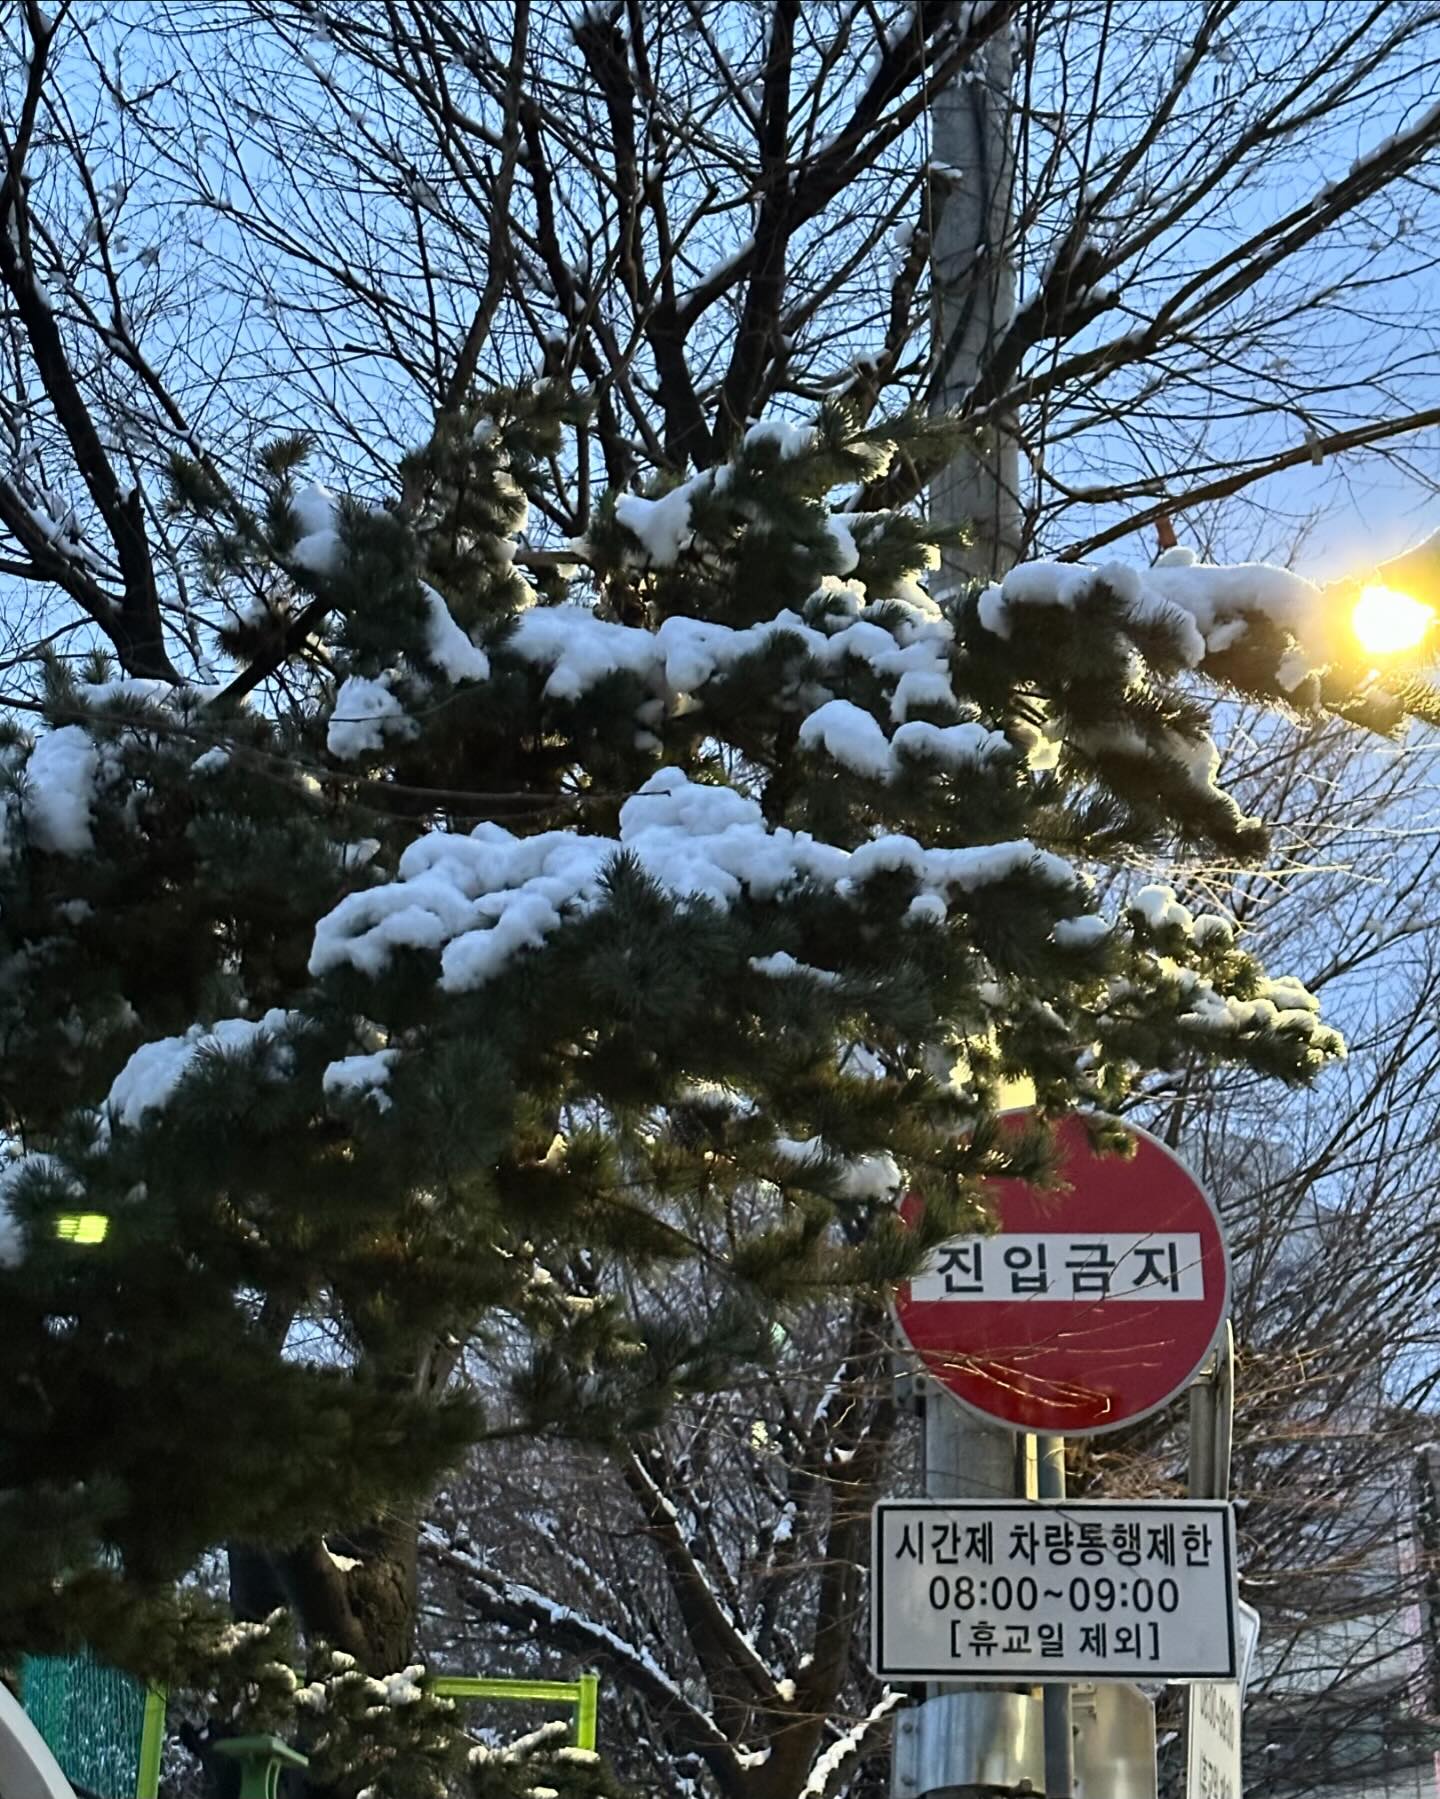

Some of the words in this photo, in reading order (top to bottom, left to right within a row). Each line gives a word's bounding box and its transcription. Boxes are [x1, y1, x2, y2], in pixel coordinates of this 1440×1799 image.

[936, 1242, 1179, 1293] 진입금지
[895, 1520, 993, 1565] 시간제
[1008, 1521, 1212, 1567] 차량통행제한
[929, 1576, 1179, 1612] 08:00~09:00
[950, 1620, 1064, 1658] [휴교일
[1079, 1622, 1159, 1660] 제외]
